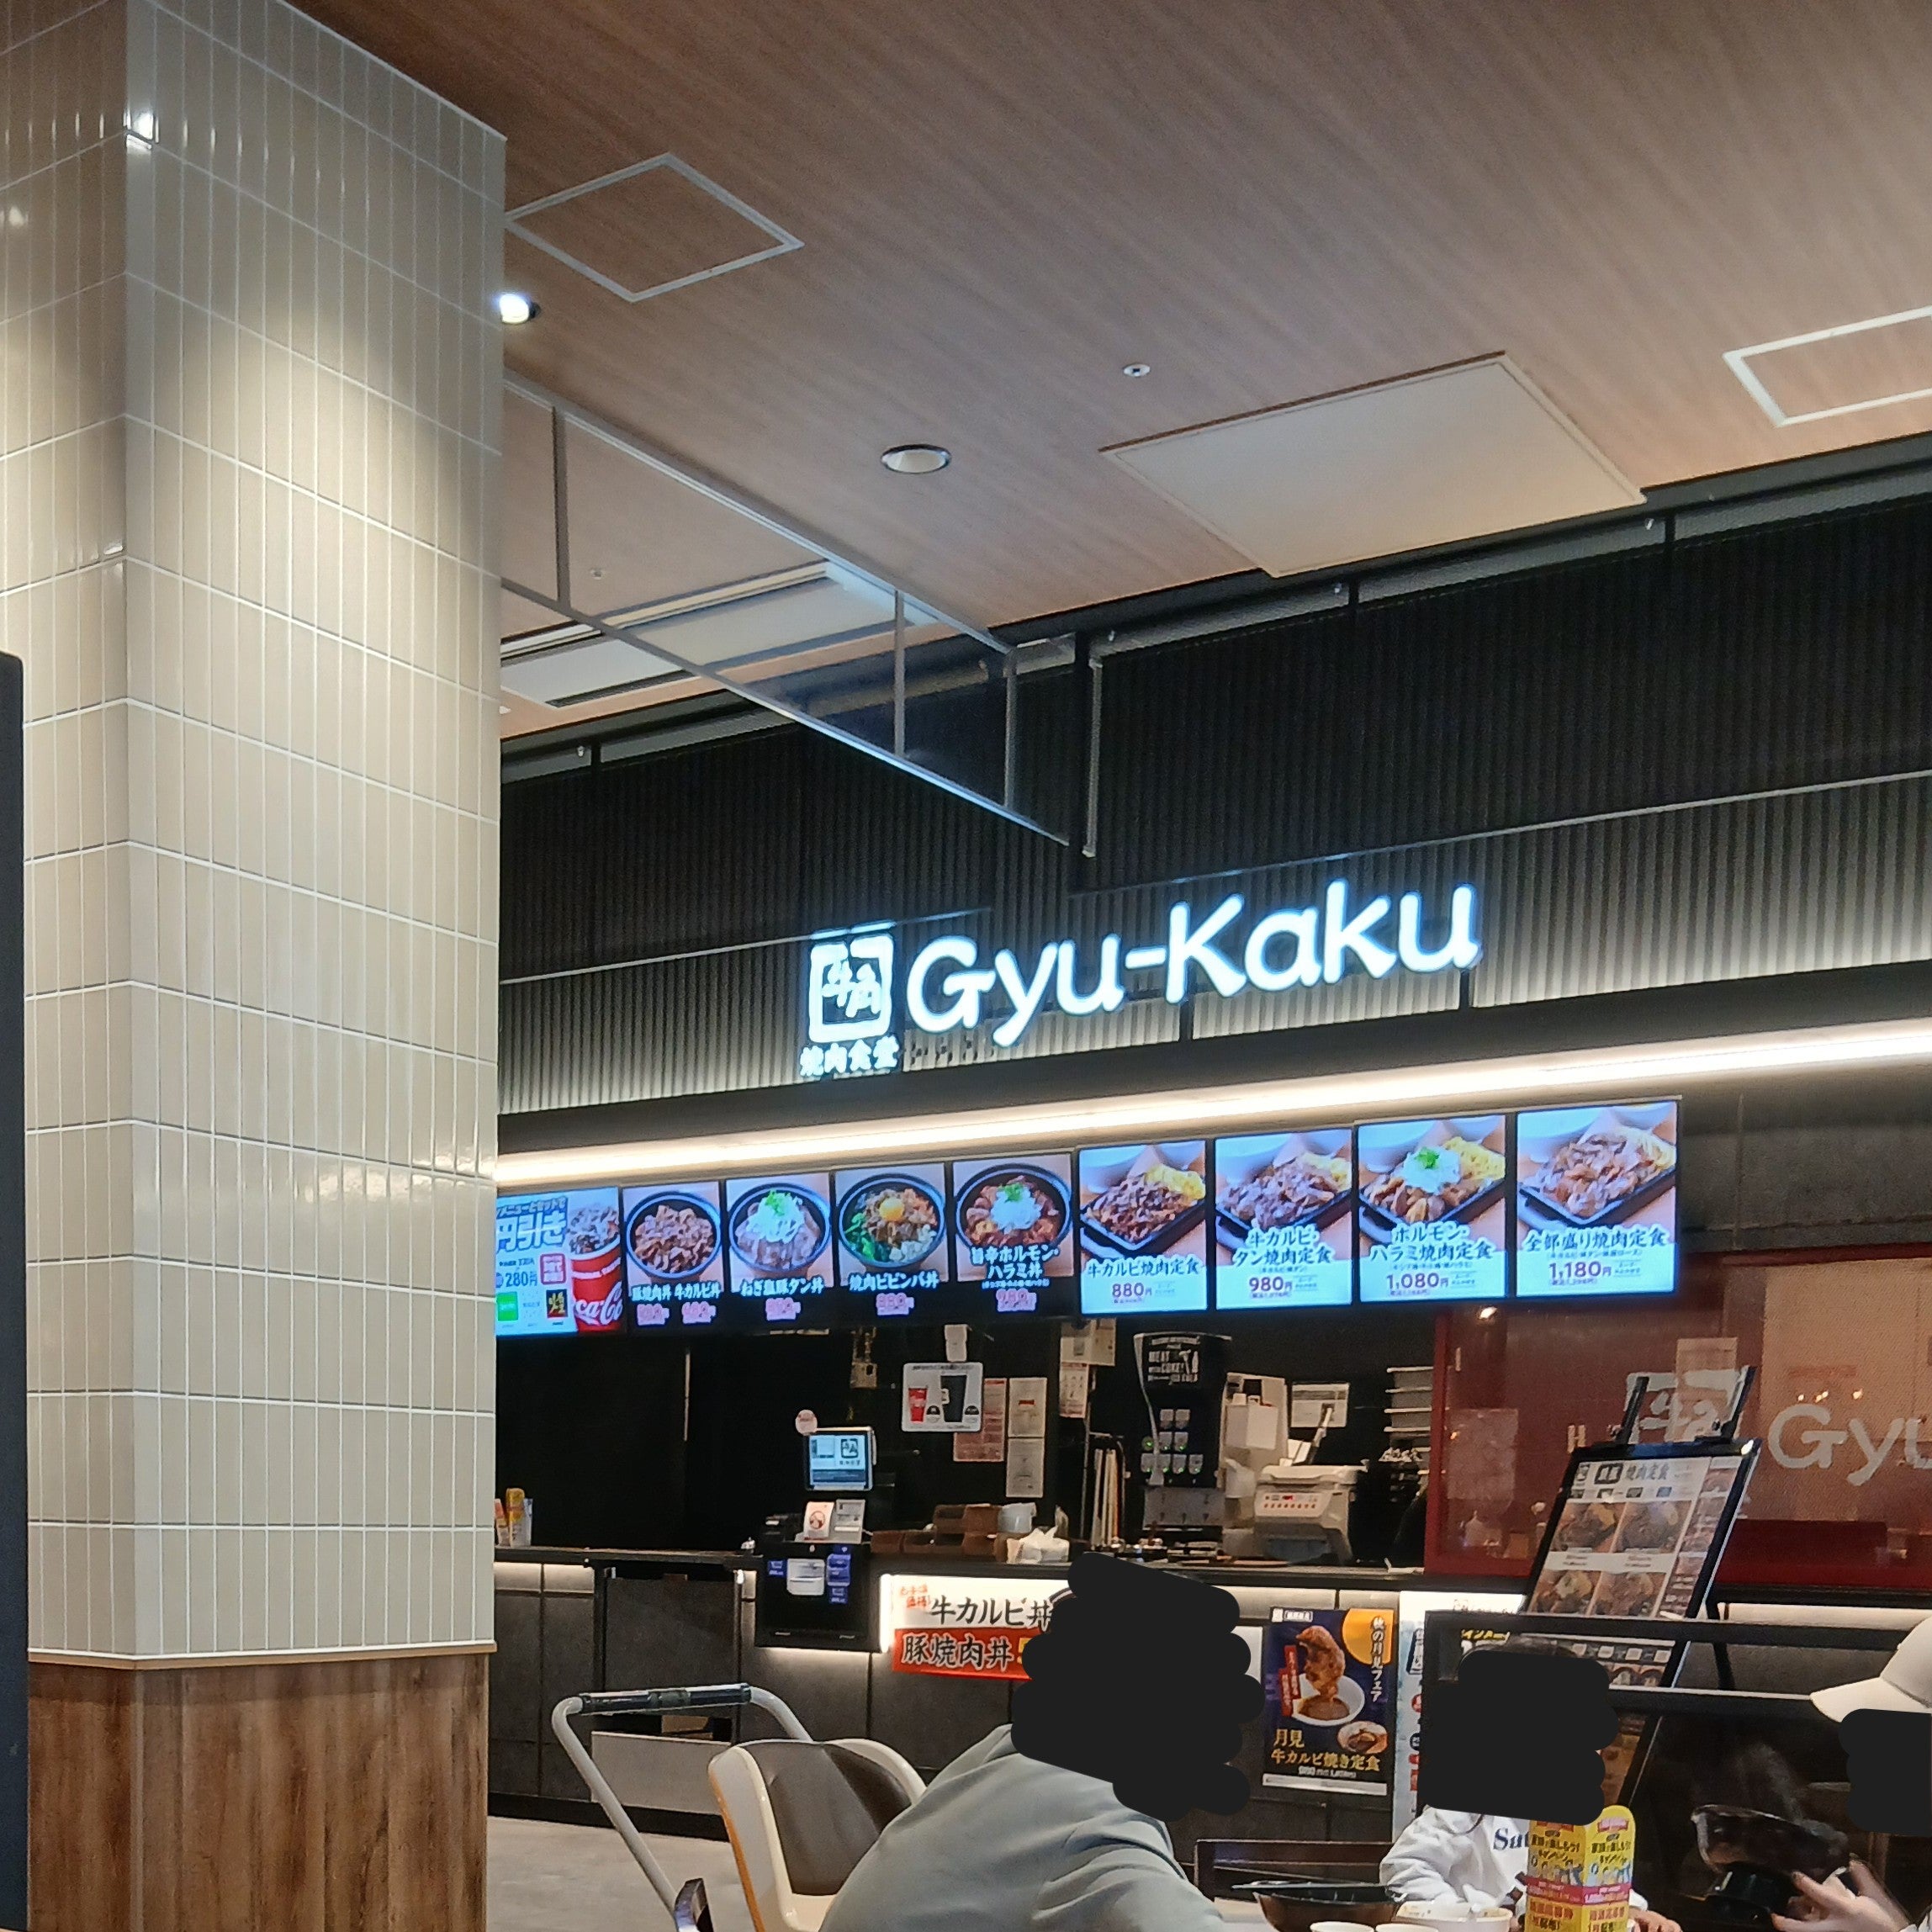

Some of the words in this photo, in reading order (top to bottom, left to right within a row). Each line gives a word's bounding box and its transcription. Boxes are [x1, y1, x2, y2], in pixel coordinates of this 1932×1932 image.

[906, 880, 1482, 1048] Gyu-Kaku
[1370, 1240, 1493, 1262] ハラミ焼肉定食
[1525, 1228, 1669, 1252] 全部盛り焼肉定食
[1088, 1256, 1200, 1278] 牛カルビ焼肉定食
[1234, 1247, 1332, 1268] タン焼肉定食
[1549, 1261, 1612, 1278] 1,180円
[1112, 1282, 1152, 1297] 880円
[1248, 1276, 1292, 1292] 980円
[1386, 1272, 1449, 1290] 1,080円
[931, 1595, 1052, 1632] 牛カルビ丼
[903, 1633, 1013, 1671] 豚焼肉丼
[1273, 1728, 1305, 1749] 月見
[1271, 1748, 1381, 1771] 牛カルビ焼き定食
